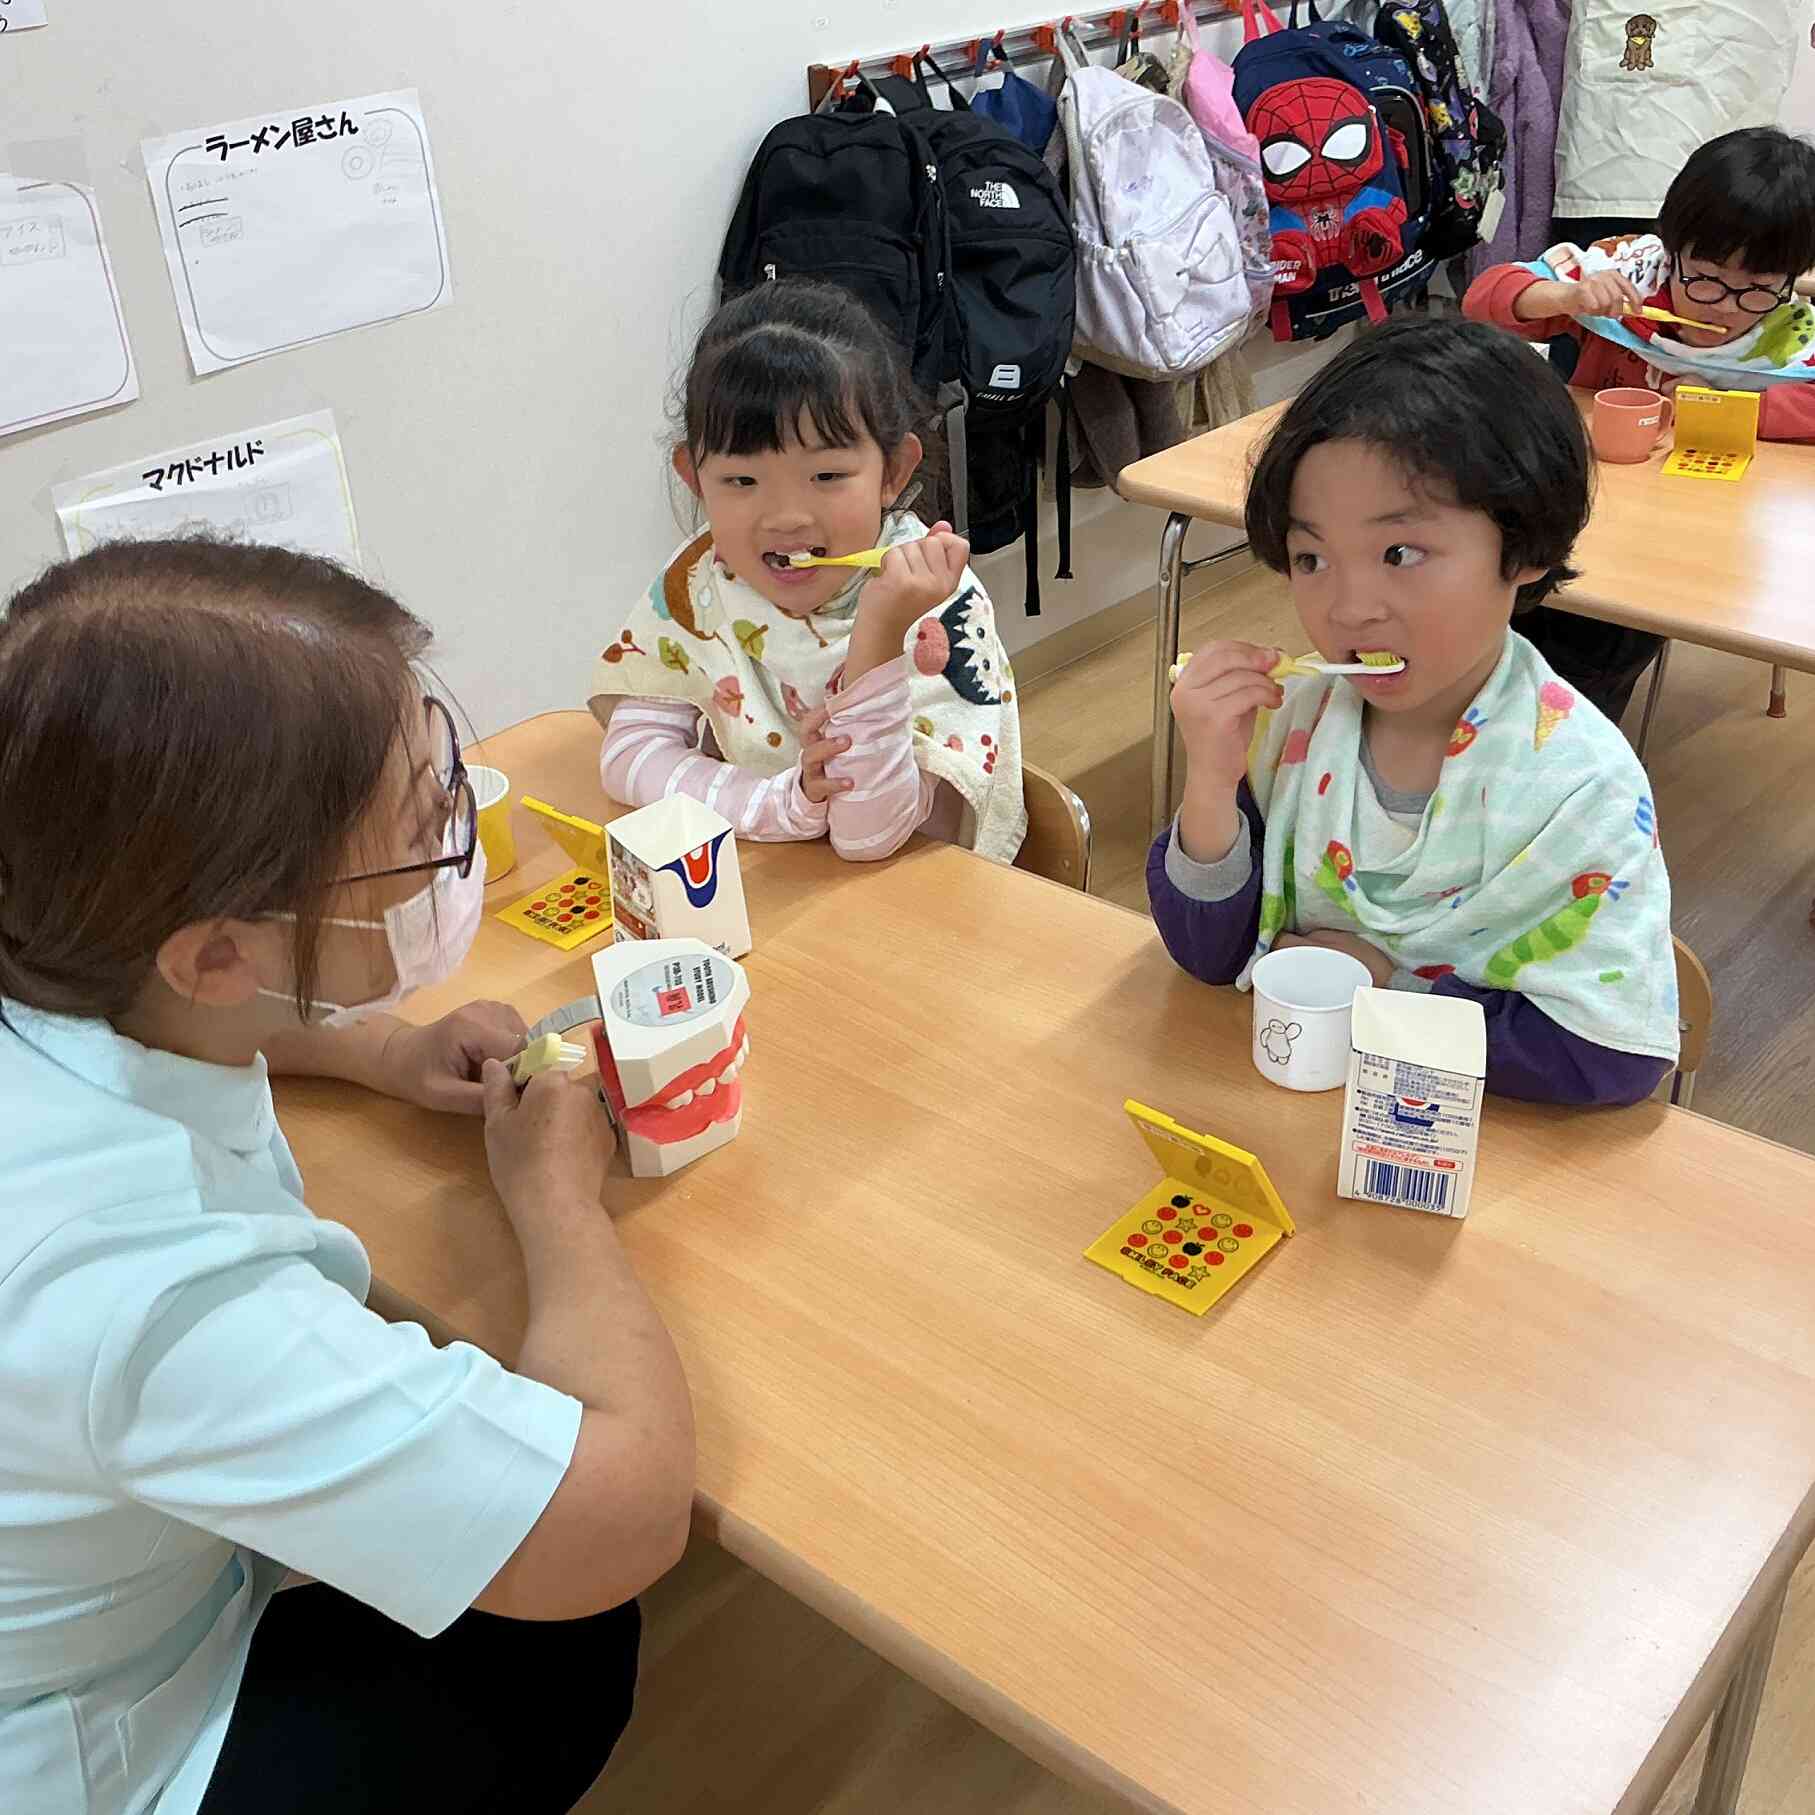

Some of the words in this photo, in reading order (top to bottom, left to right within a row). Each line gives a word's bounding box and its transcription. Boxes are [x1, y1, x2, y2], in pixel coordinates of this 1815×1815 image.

[205, 111, 359, 161] ラーメン屋さん
[985, 181, 1001, 191] THE
[970, 189, 1001, 200] NORTH
[980, 199, 1002, 207] FACE
[142, 440, 264, 491] マクドナルド
